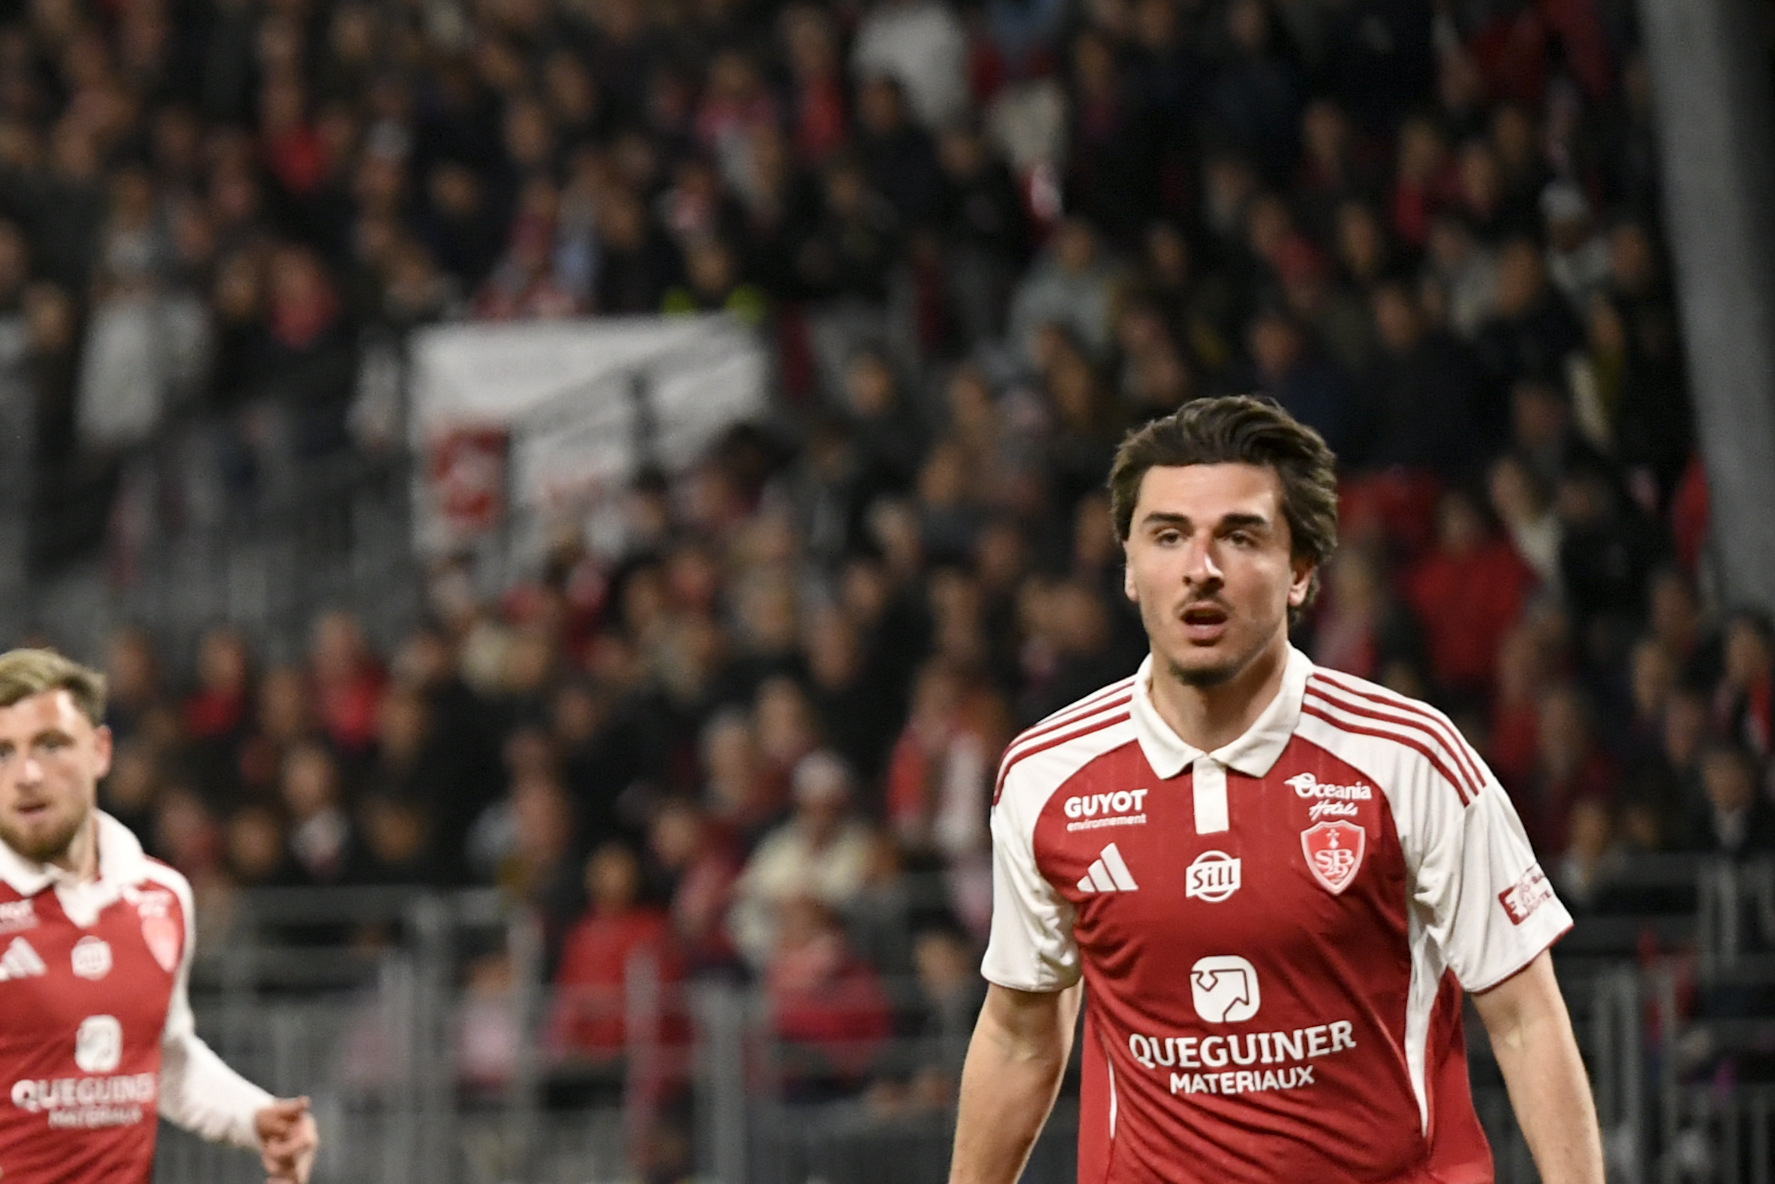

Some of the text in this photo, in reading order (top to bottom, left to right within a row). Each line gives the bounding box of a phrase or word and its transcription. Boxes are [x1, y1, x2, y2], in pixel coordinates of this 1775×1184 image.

[1284, 772, 1372, 800] Oceania
[1064, 788, 1148, 818] GUYOT
[1129, 1020, 1356, 1068] QUEGUINER
[1170, 1065, 1315, 1094] MATERIAUX
